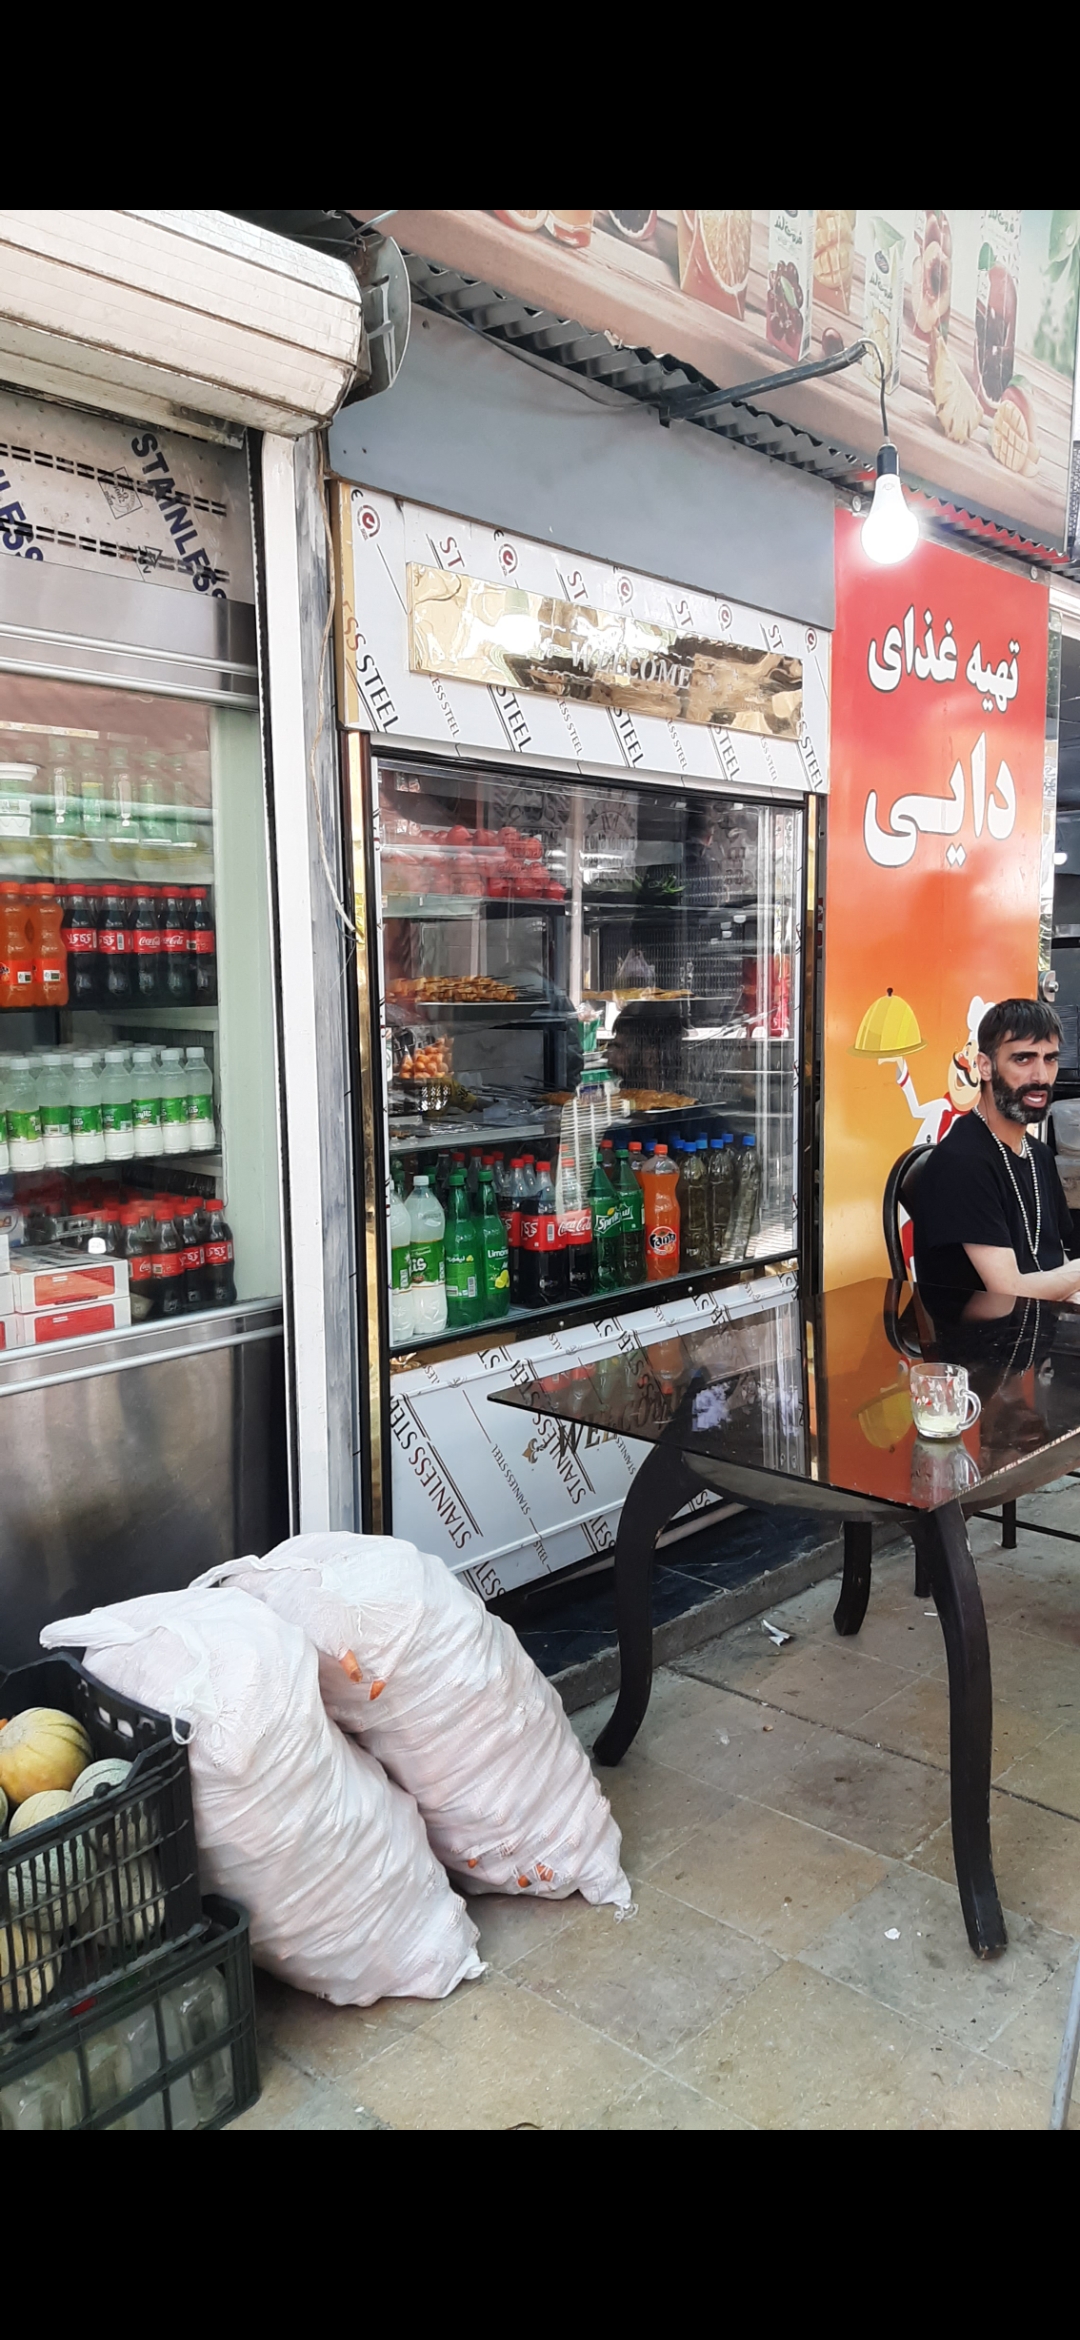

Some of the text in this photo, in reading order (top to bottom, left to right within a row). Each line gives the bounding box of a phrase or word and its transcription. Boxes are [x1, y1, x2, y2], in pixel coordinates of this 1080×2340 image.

[356, 654, 399, 733] STEEL
[570, 639, 692, 690] WELCOME
[867, 602, 1021, 714] تهیه غذای
[800, 735, 824, 793] STEEL
[863, 730, 1017, 868] دایی
[648, 1232, 677, 1249] Fanta
[390, 1394, 472, 1549] STAINLESS STEE
[491, 1443, 532, 1516] STAINLESS STEEL
